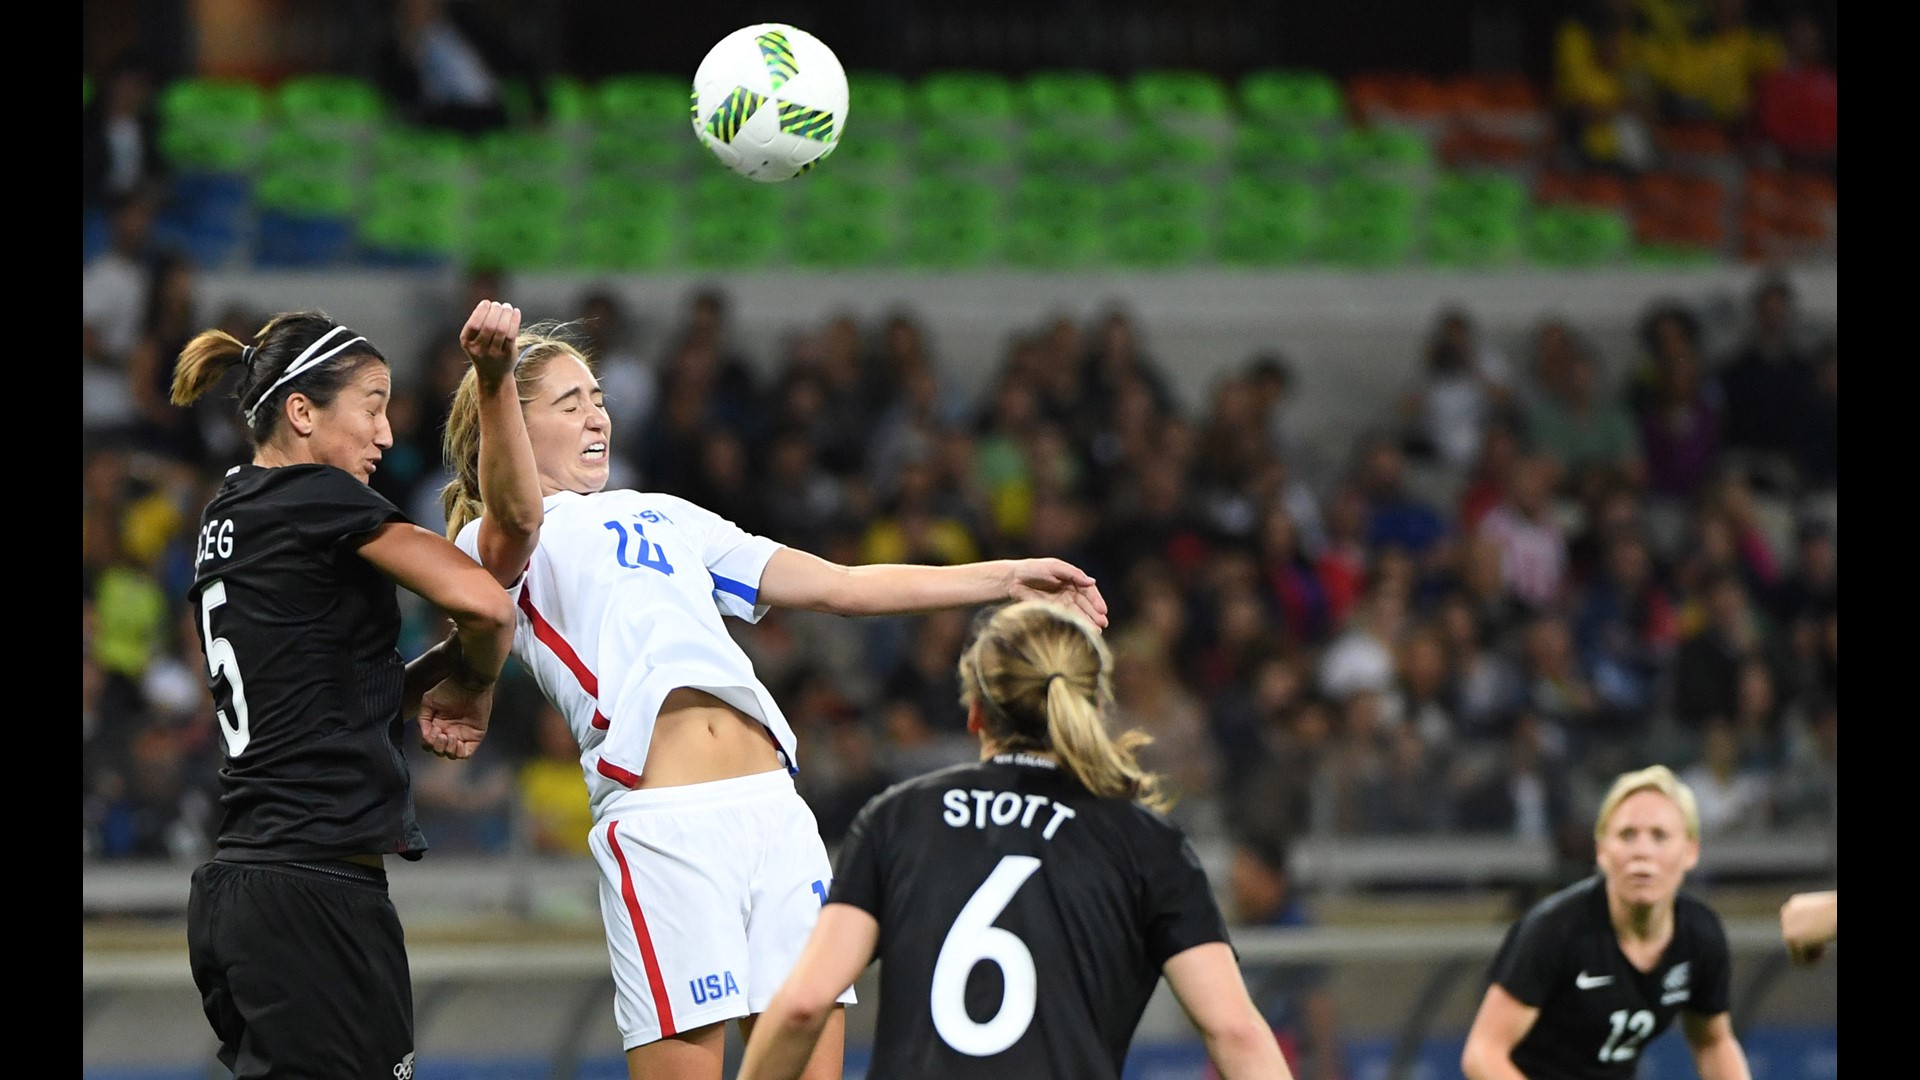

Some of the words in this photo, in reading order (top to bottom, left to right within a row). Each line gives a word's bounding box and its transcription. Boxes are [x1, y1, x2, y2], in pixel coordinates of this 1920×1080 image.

[603, 520, 674, 576] 14
[202, 578, 250, 757] 5
[943, 788, 1076, 840] STOTT
[931, 855, 1042, 1057] 6
[689, 970, 740, 1005] USA
[1598, 1009, 1656, 1062] 12
